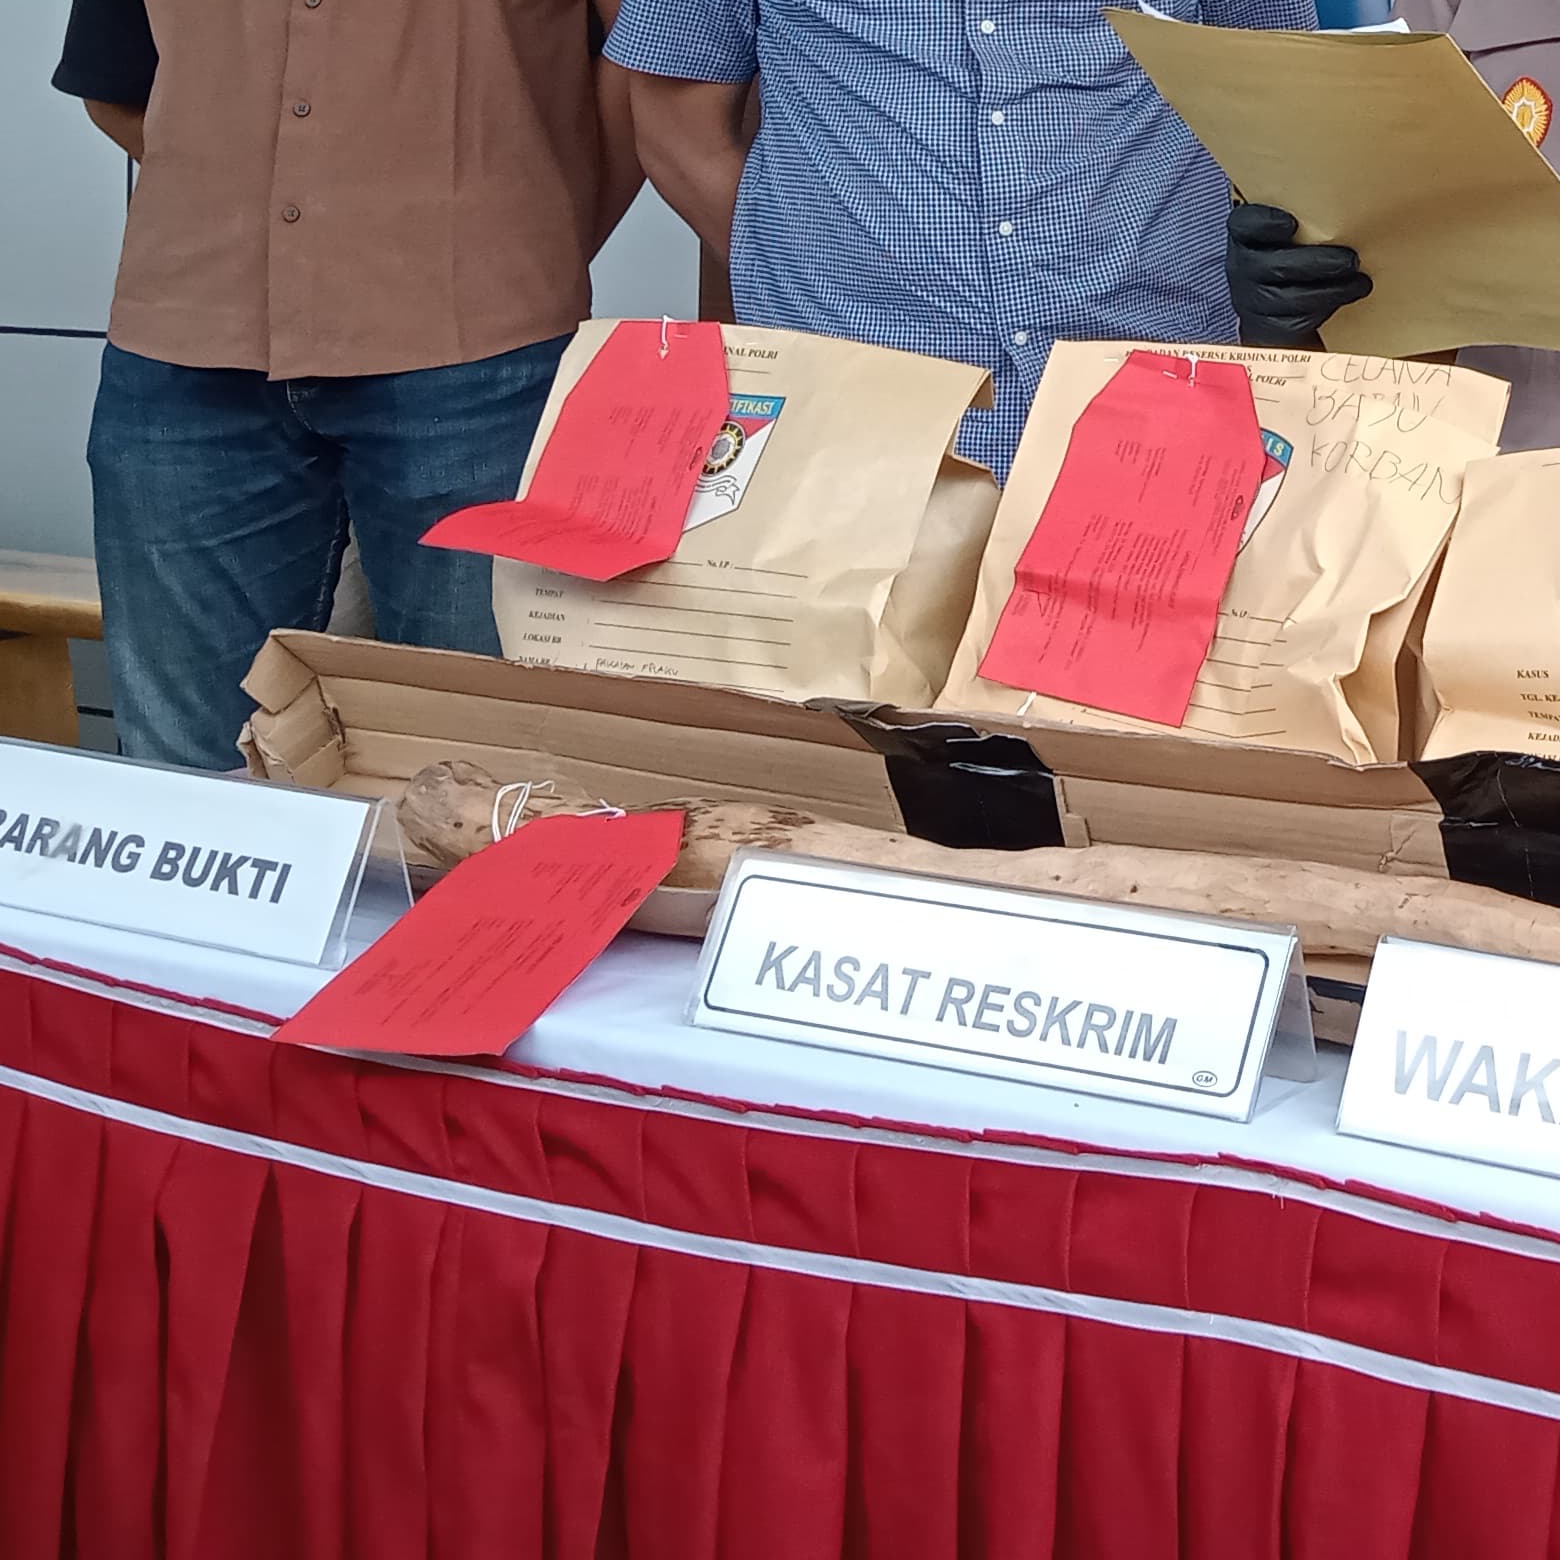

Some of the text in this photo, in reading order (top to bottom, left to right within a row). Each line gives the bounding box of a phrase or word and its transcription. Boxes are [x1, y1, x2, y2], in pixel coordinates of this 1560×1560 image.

[748, 348, 779, 360] POLRI
[1228, 351, 1280, 364] KRIMINAL
[1281, 354, 1312, 364] POLRI
[1255, 374, 1288, 387] POLRI
[1310, 433, 1462, 505] KORBAN
[527, 609, 566, 622] KEJADIAN
[1516, 669, 1550, 680] KASUS
[0, 808, 293, 905] ARANG BUKTI
[754, 940, 1179, 1065] KASAT RESKRIM
